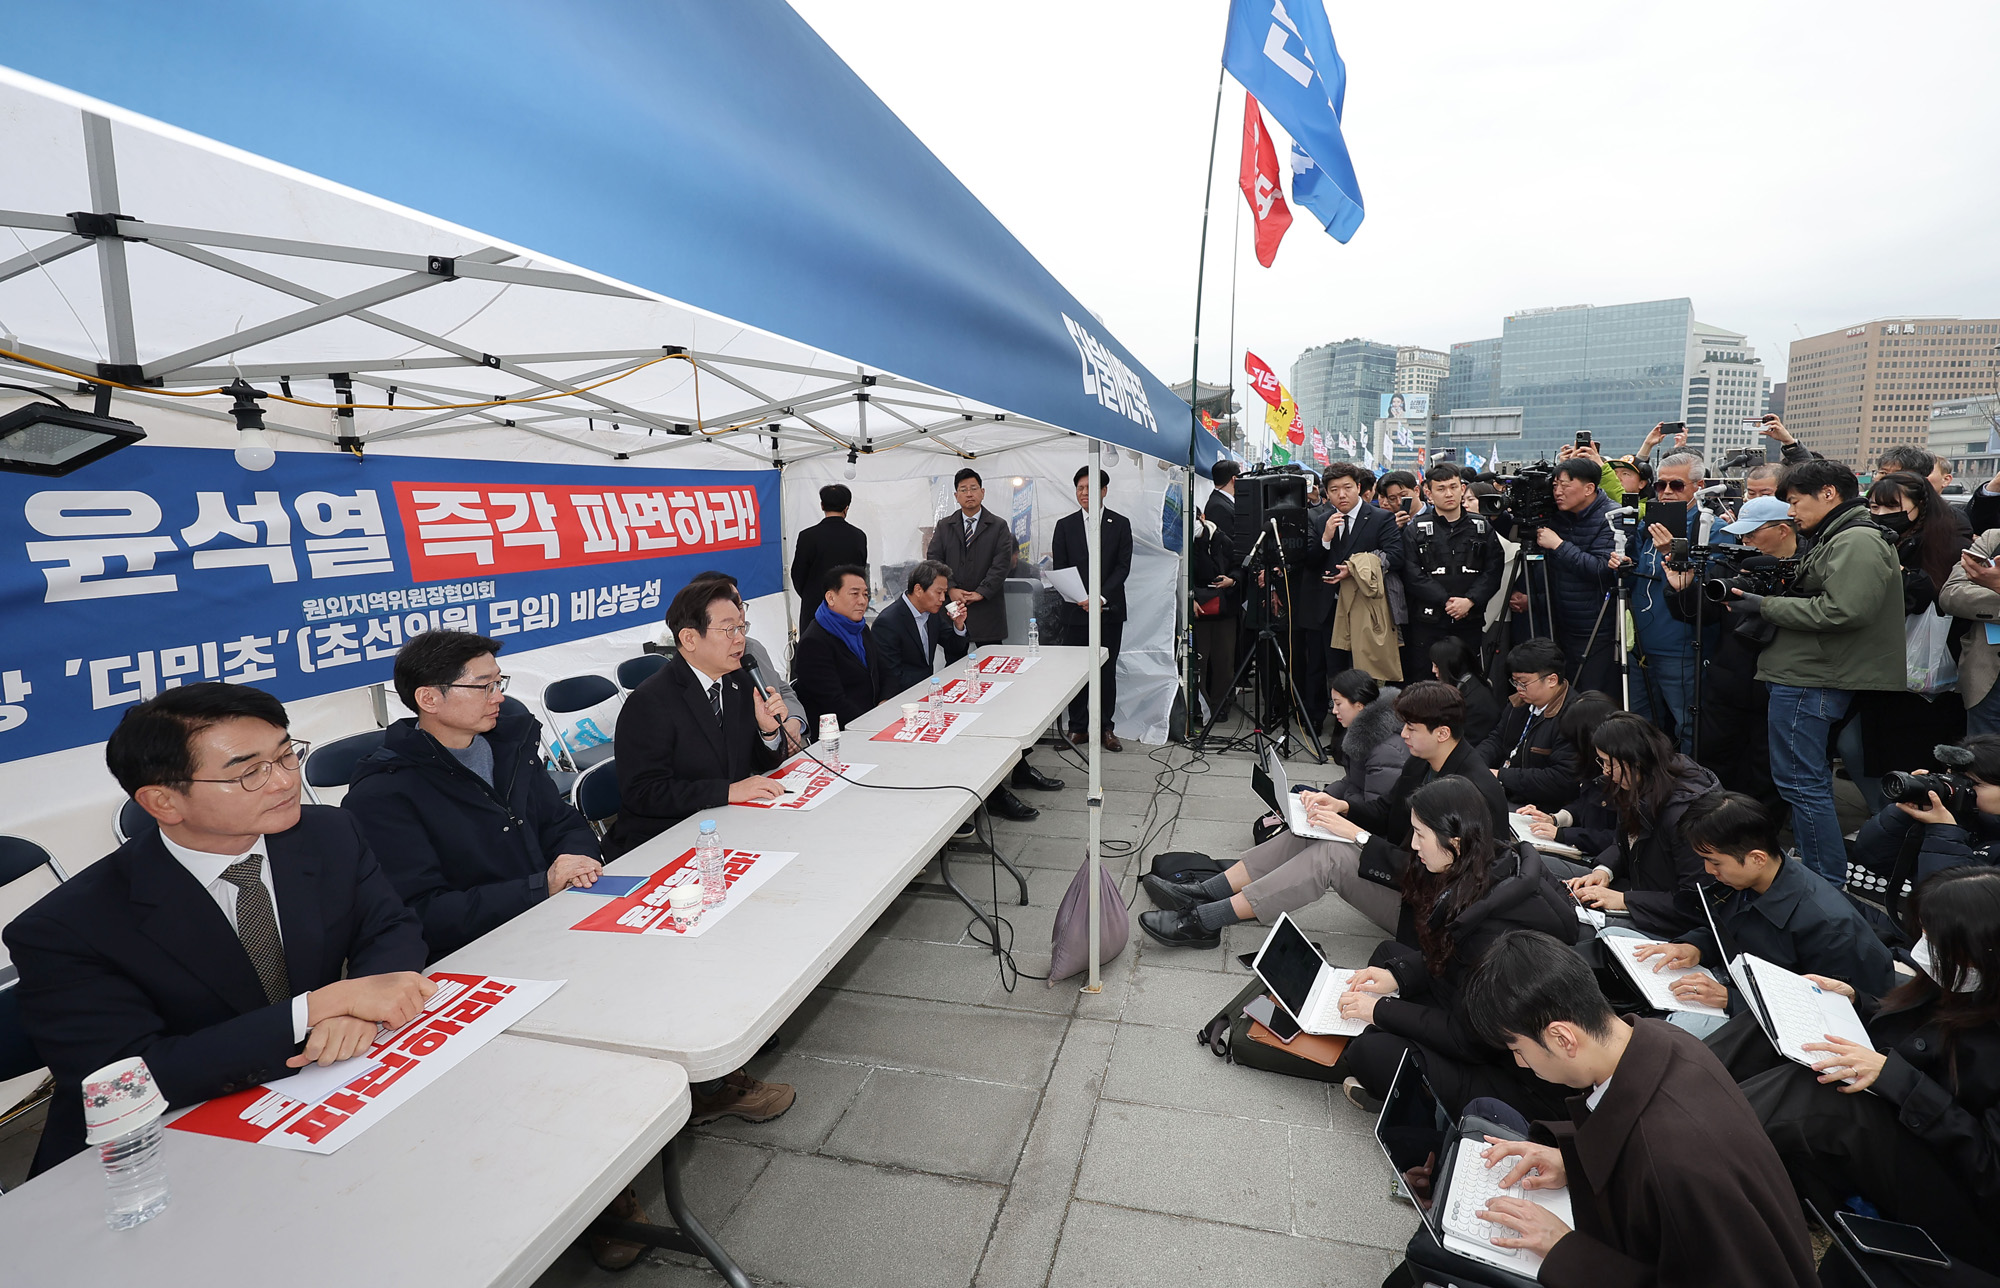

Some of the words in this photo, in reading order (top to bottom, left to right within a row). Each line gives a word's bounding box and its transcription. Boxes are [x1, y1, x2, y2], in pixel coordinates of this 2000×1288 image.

[24, 489, 395, 603] 윤석열
[412, 490, 560, 565] 즉각
[570, 489, 757, 553] 파면하라!
[1267, 536, 1304, 549] MPRO
[302, 580, 497, 622] 원외지역위원장협의회
[488, 592, 560, 638] 모임)
[570, 578, 662, 623] 비상농성
[283, 980, 517, 1145] 파면하라!
